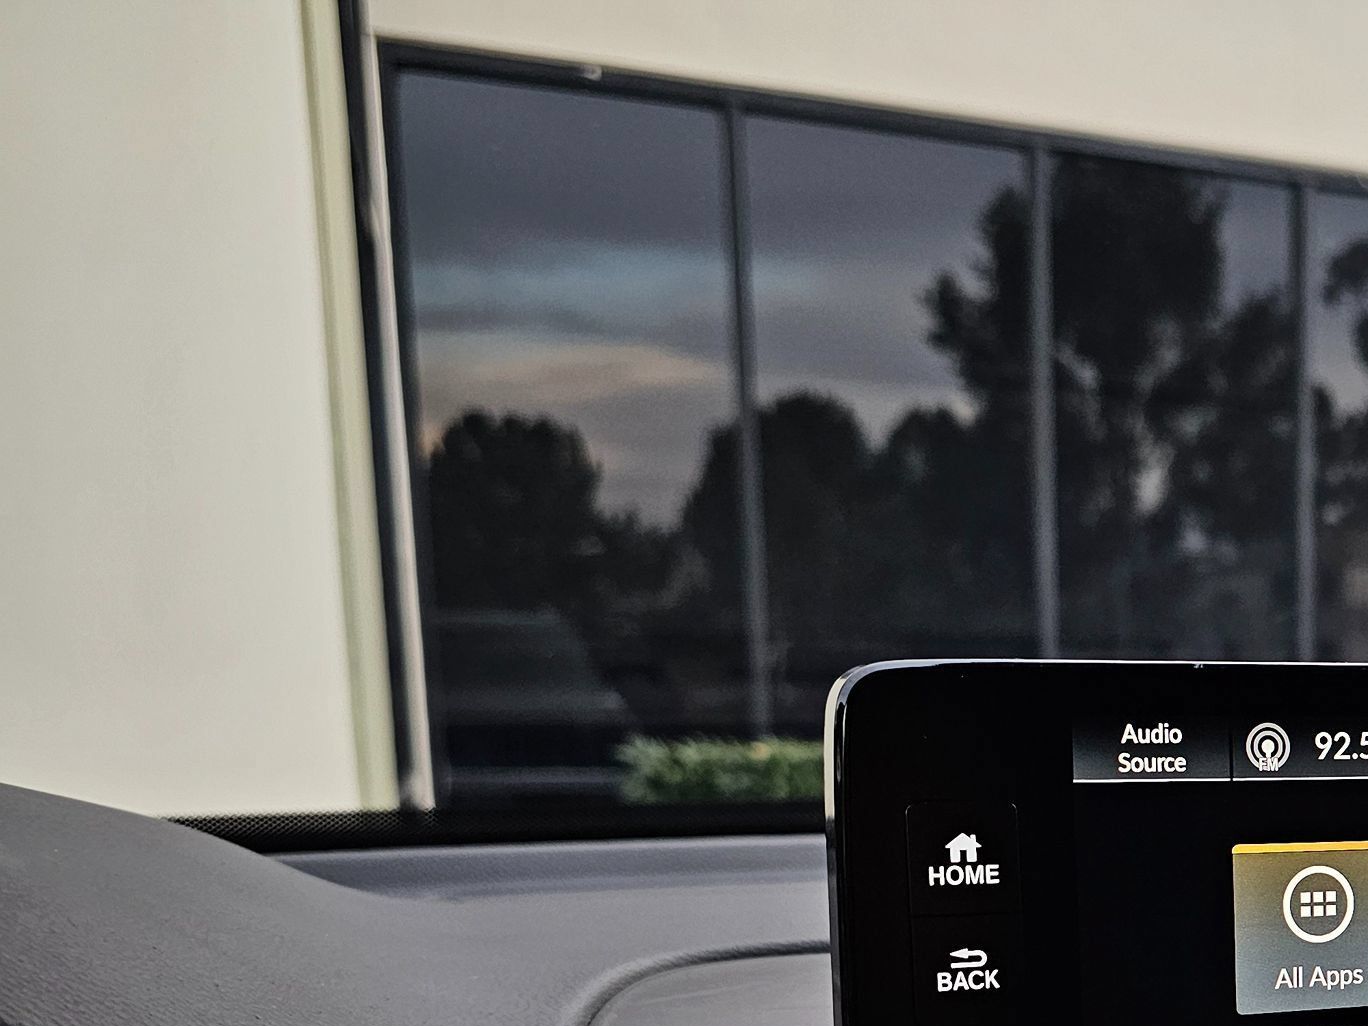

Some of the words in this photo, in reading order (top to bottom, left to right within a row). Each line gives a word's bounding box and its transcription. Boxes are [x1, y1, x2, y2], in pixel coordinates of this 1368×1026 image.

[1120, 722, 1183, 744] Audio
[1117, 752, 1187, 773] Source
[1259, 757, 1279, 771] FM
[928, 864, 1000, 886] HOME
[936, 969, 1000, 992] BACK
[1274, 966, 1304, 990] All
[1309, 965, 1364, 991] Apps
